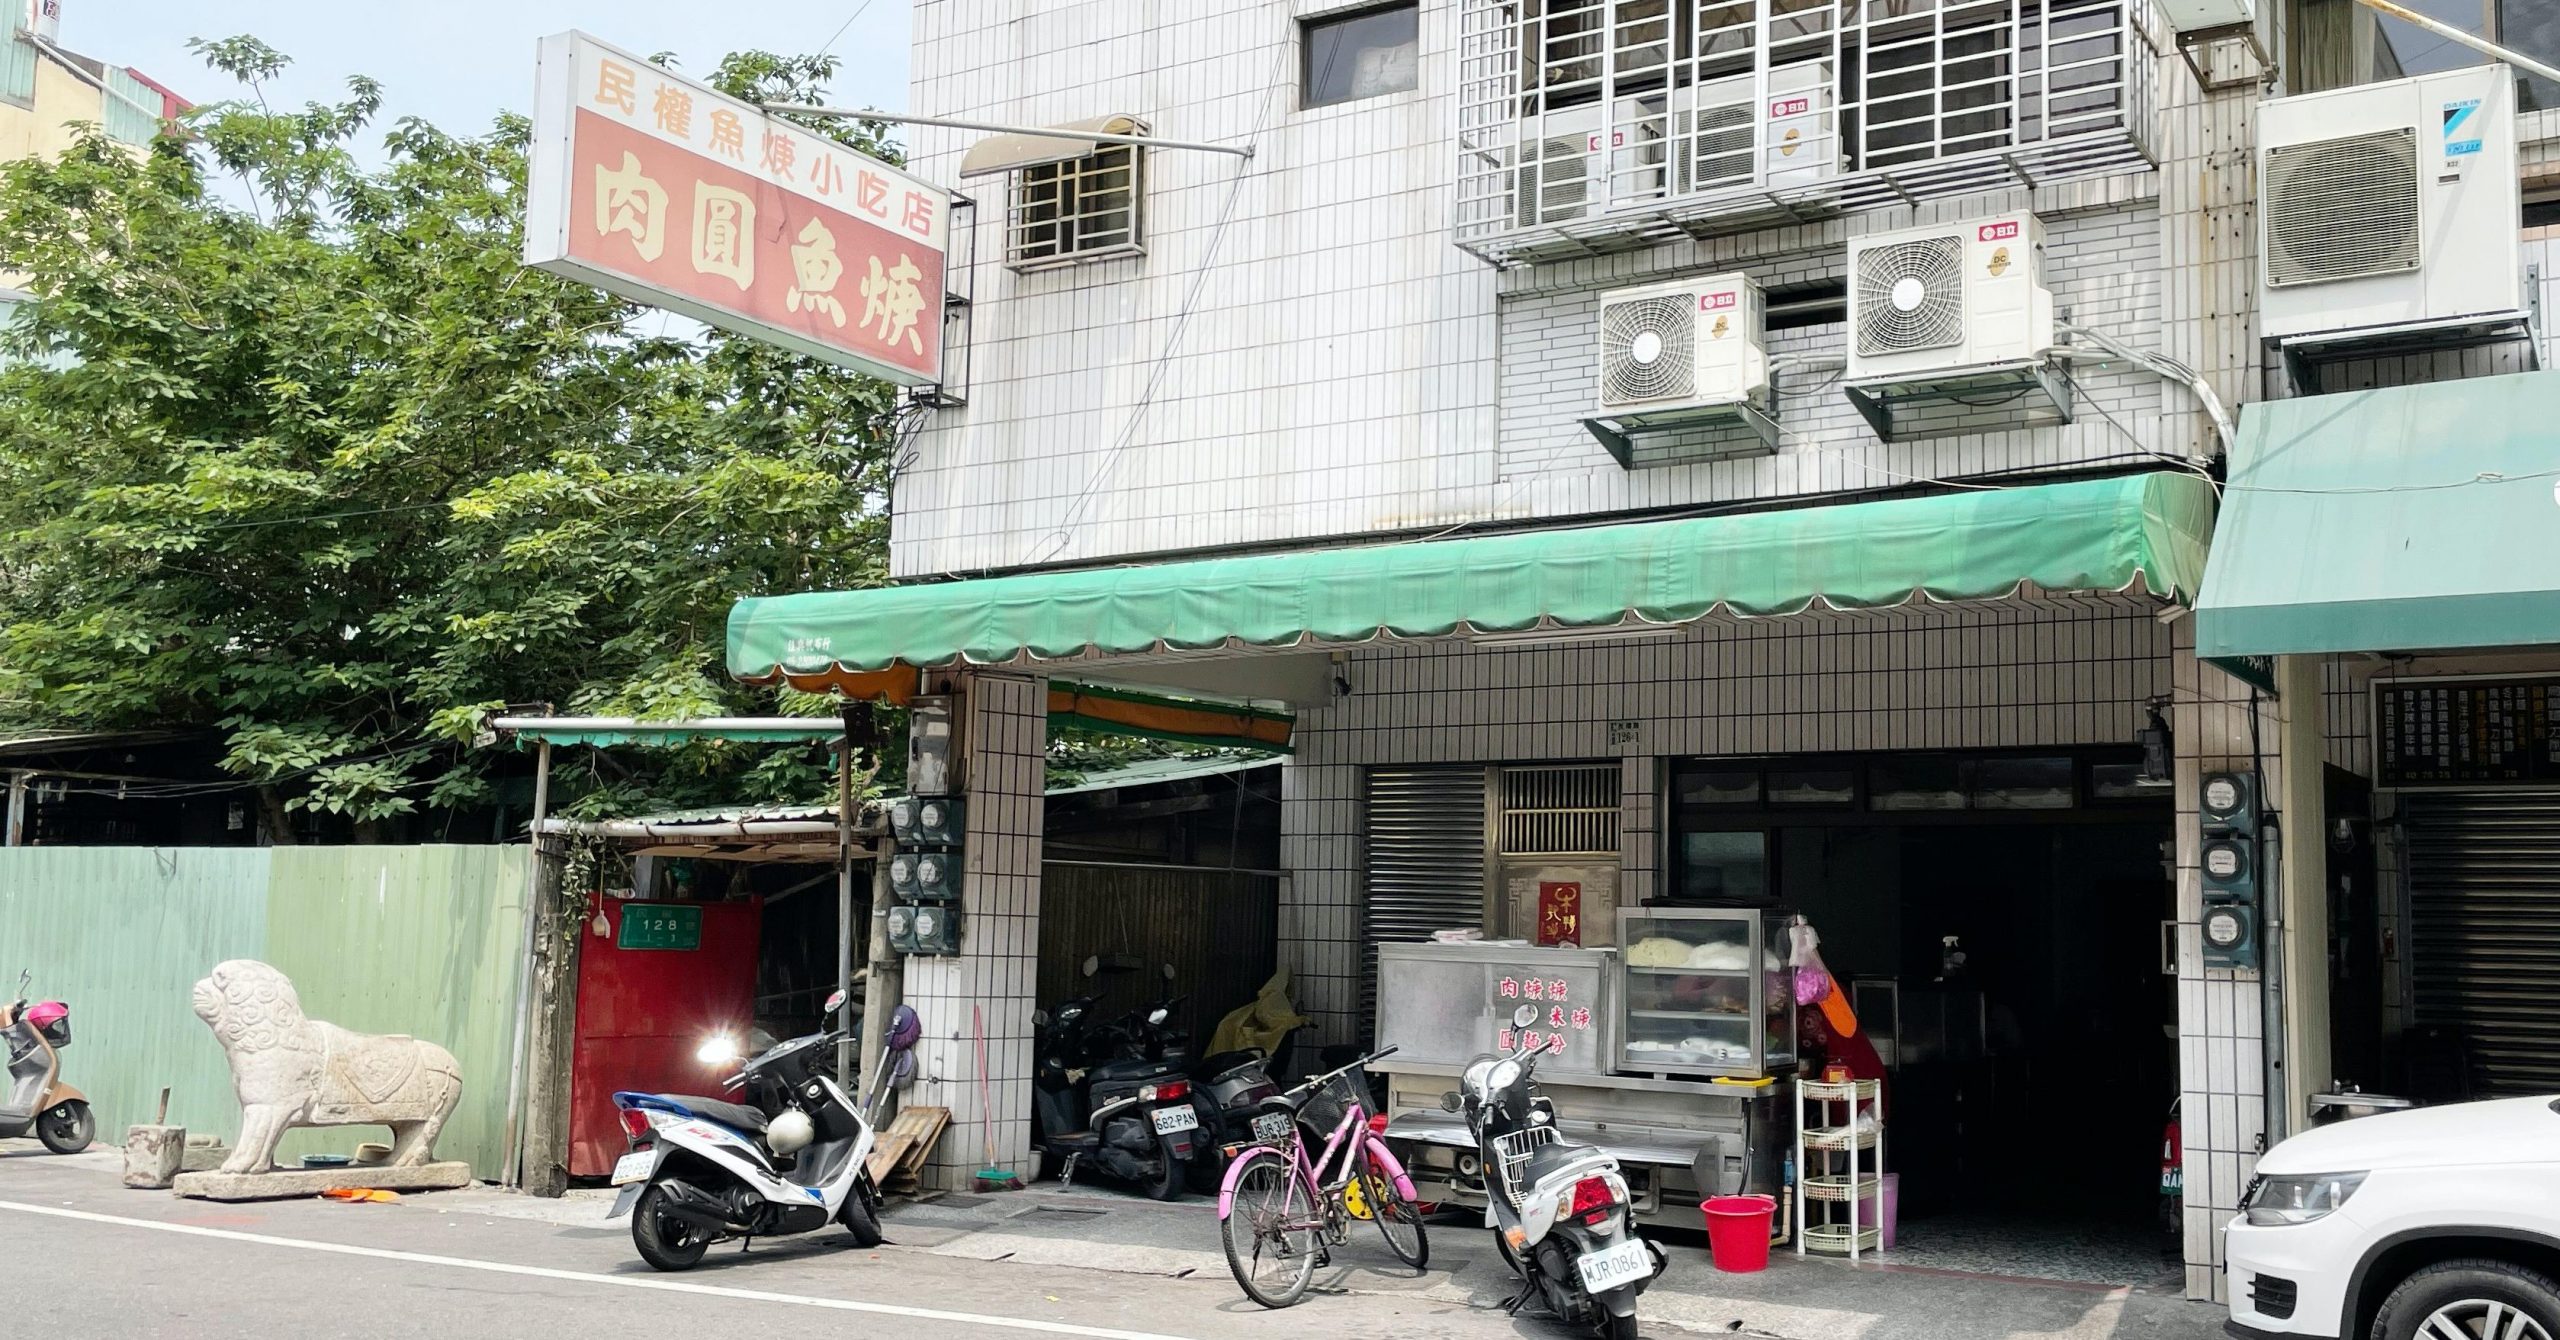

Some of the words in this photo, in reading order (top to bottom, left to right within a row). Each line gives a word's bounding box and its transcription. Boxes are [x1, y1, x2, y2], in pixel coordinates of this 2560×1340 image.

[595, 58, 934, 237] 民權魚焿小吃店
[595, 150, 926, 358] 肉圓魚焿
[643, 919, 677, 931] 128
[1155, 1112, 1196, 1131] 682-PAN
